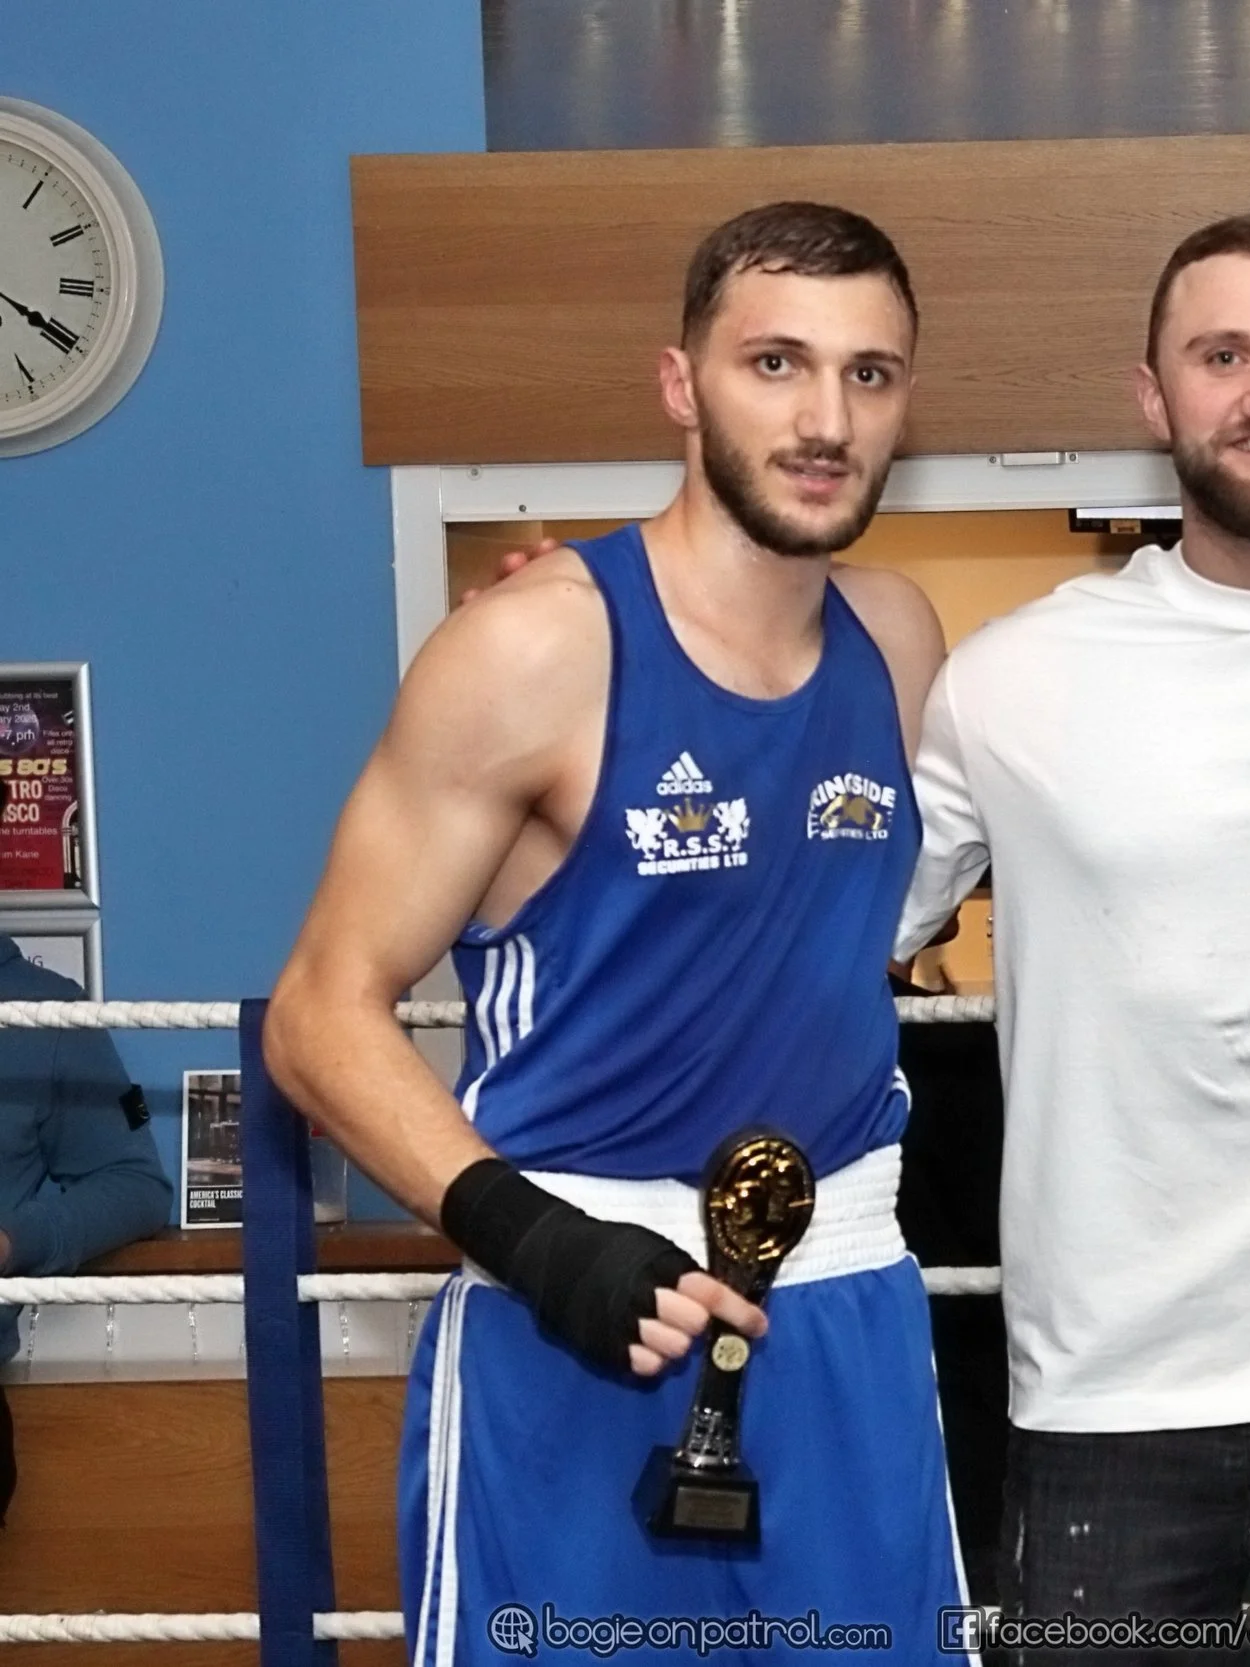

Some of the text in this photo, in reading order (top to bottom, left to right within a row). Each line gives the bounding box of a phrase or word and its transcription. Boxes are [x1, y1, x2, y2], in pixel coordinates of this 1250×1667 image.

[5, 779, 43, 799] TRO
[656, 779, 713, 796] adidas
[663, 834, 728, 858] R.S.S.
[189, 1199, 216, 1208] COCKTAIL
